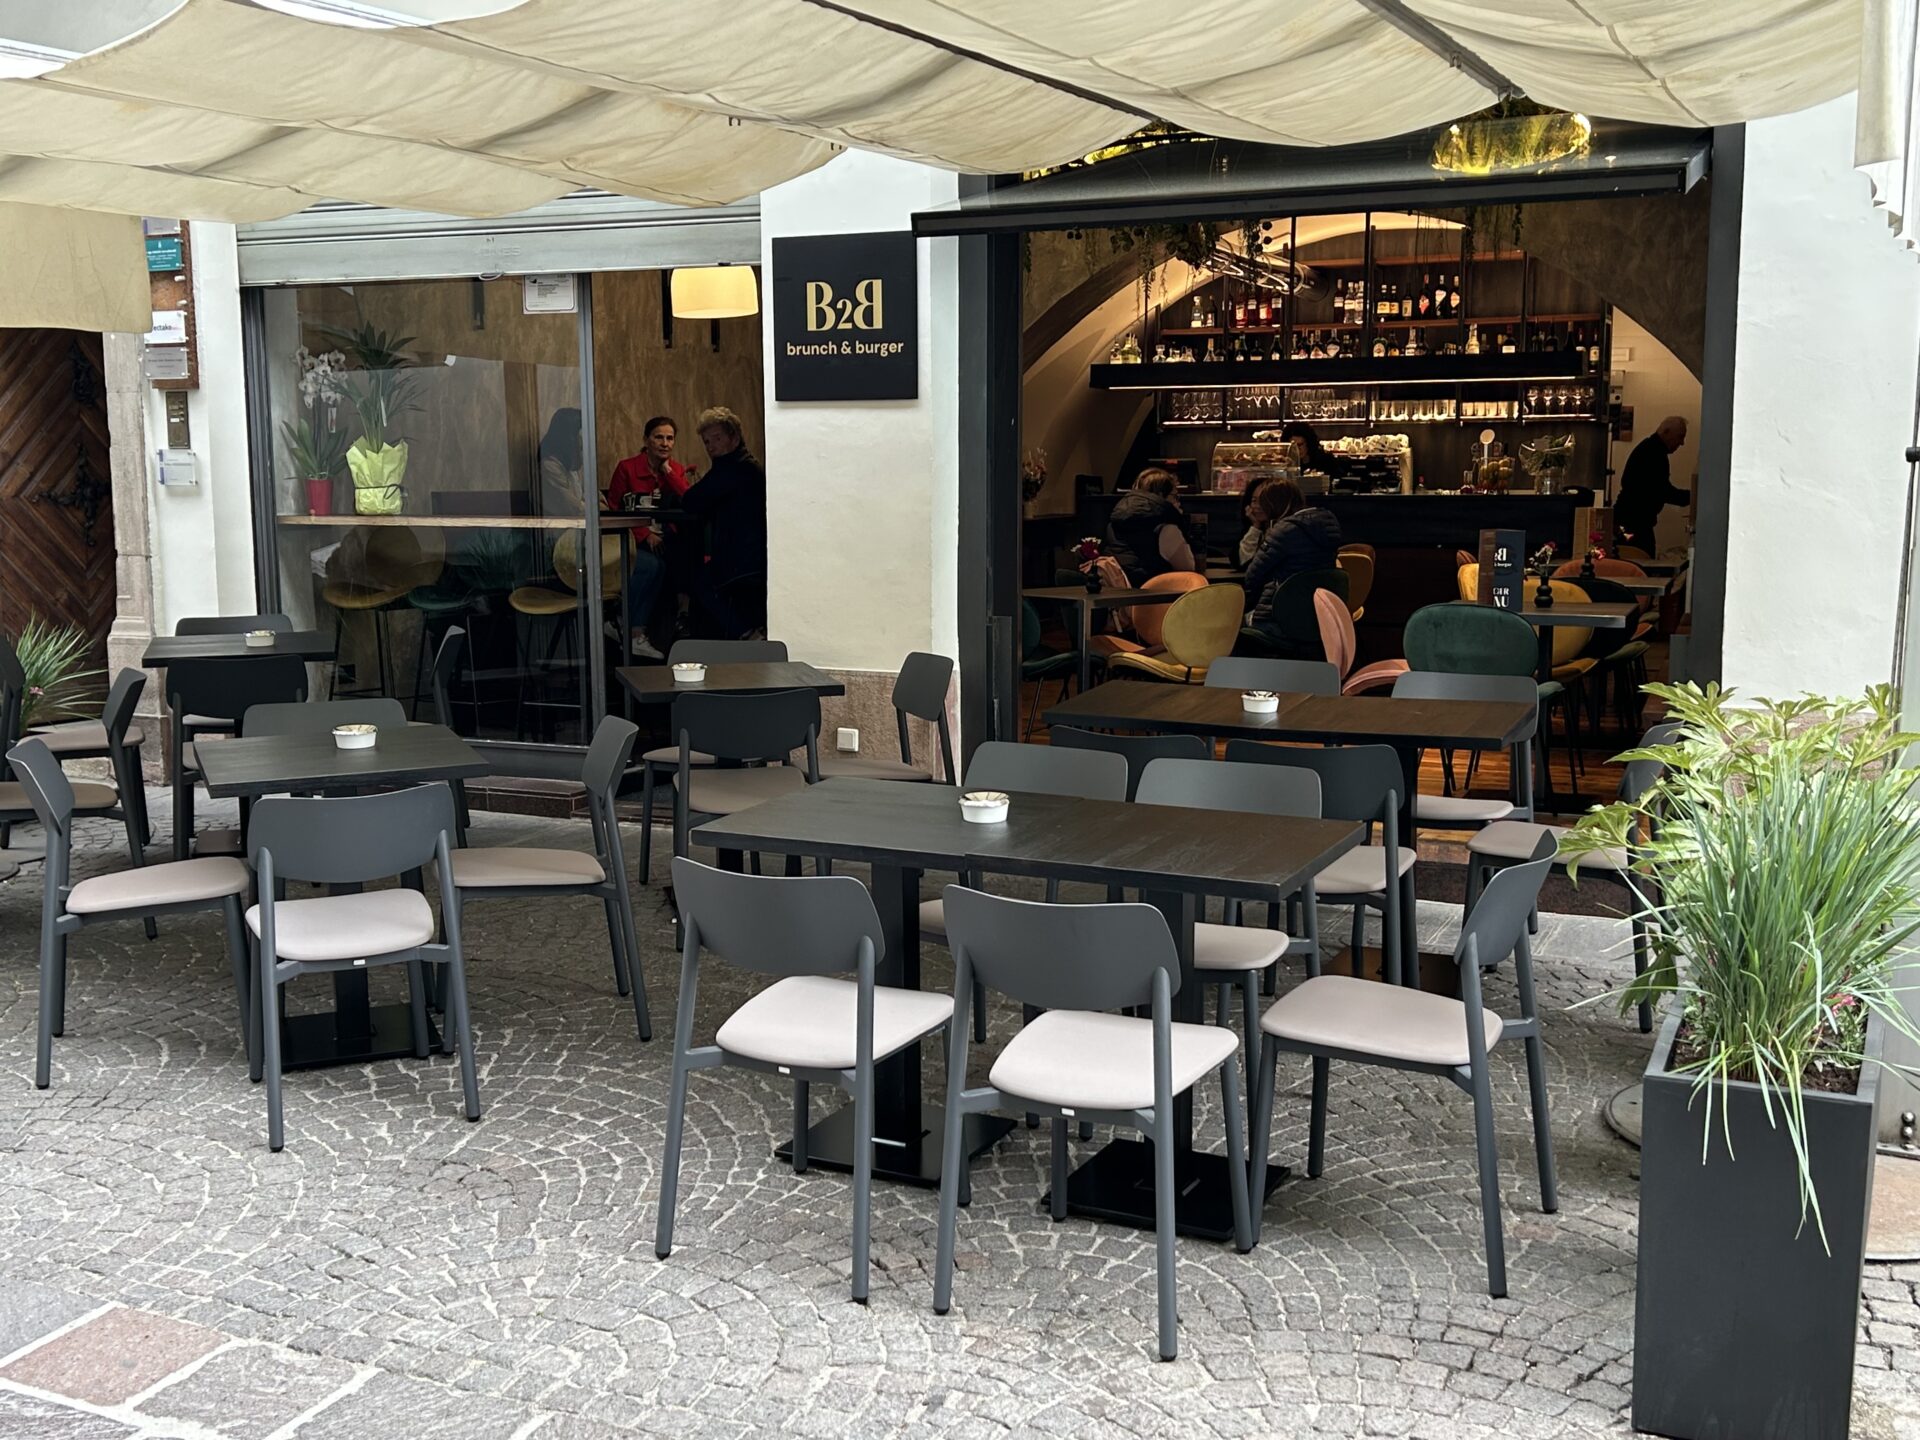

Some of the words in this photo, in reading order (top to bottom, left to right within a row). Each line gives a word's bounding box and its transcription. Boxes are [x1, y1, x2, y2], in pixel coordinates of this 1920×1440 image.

[807, 279, 882, 331] B2B
[786, 341, 838, 356] brunch
[840, 340, 852, 355] &
[855, 340, 904, 357] burger
